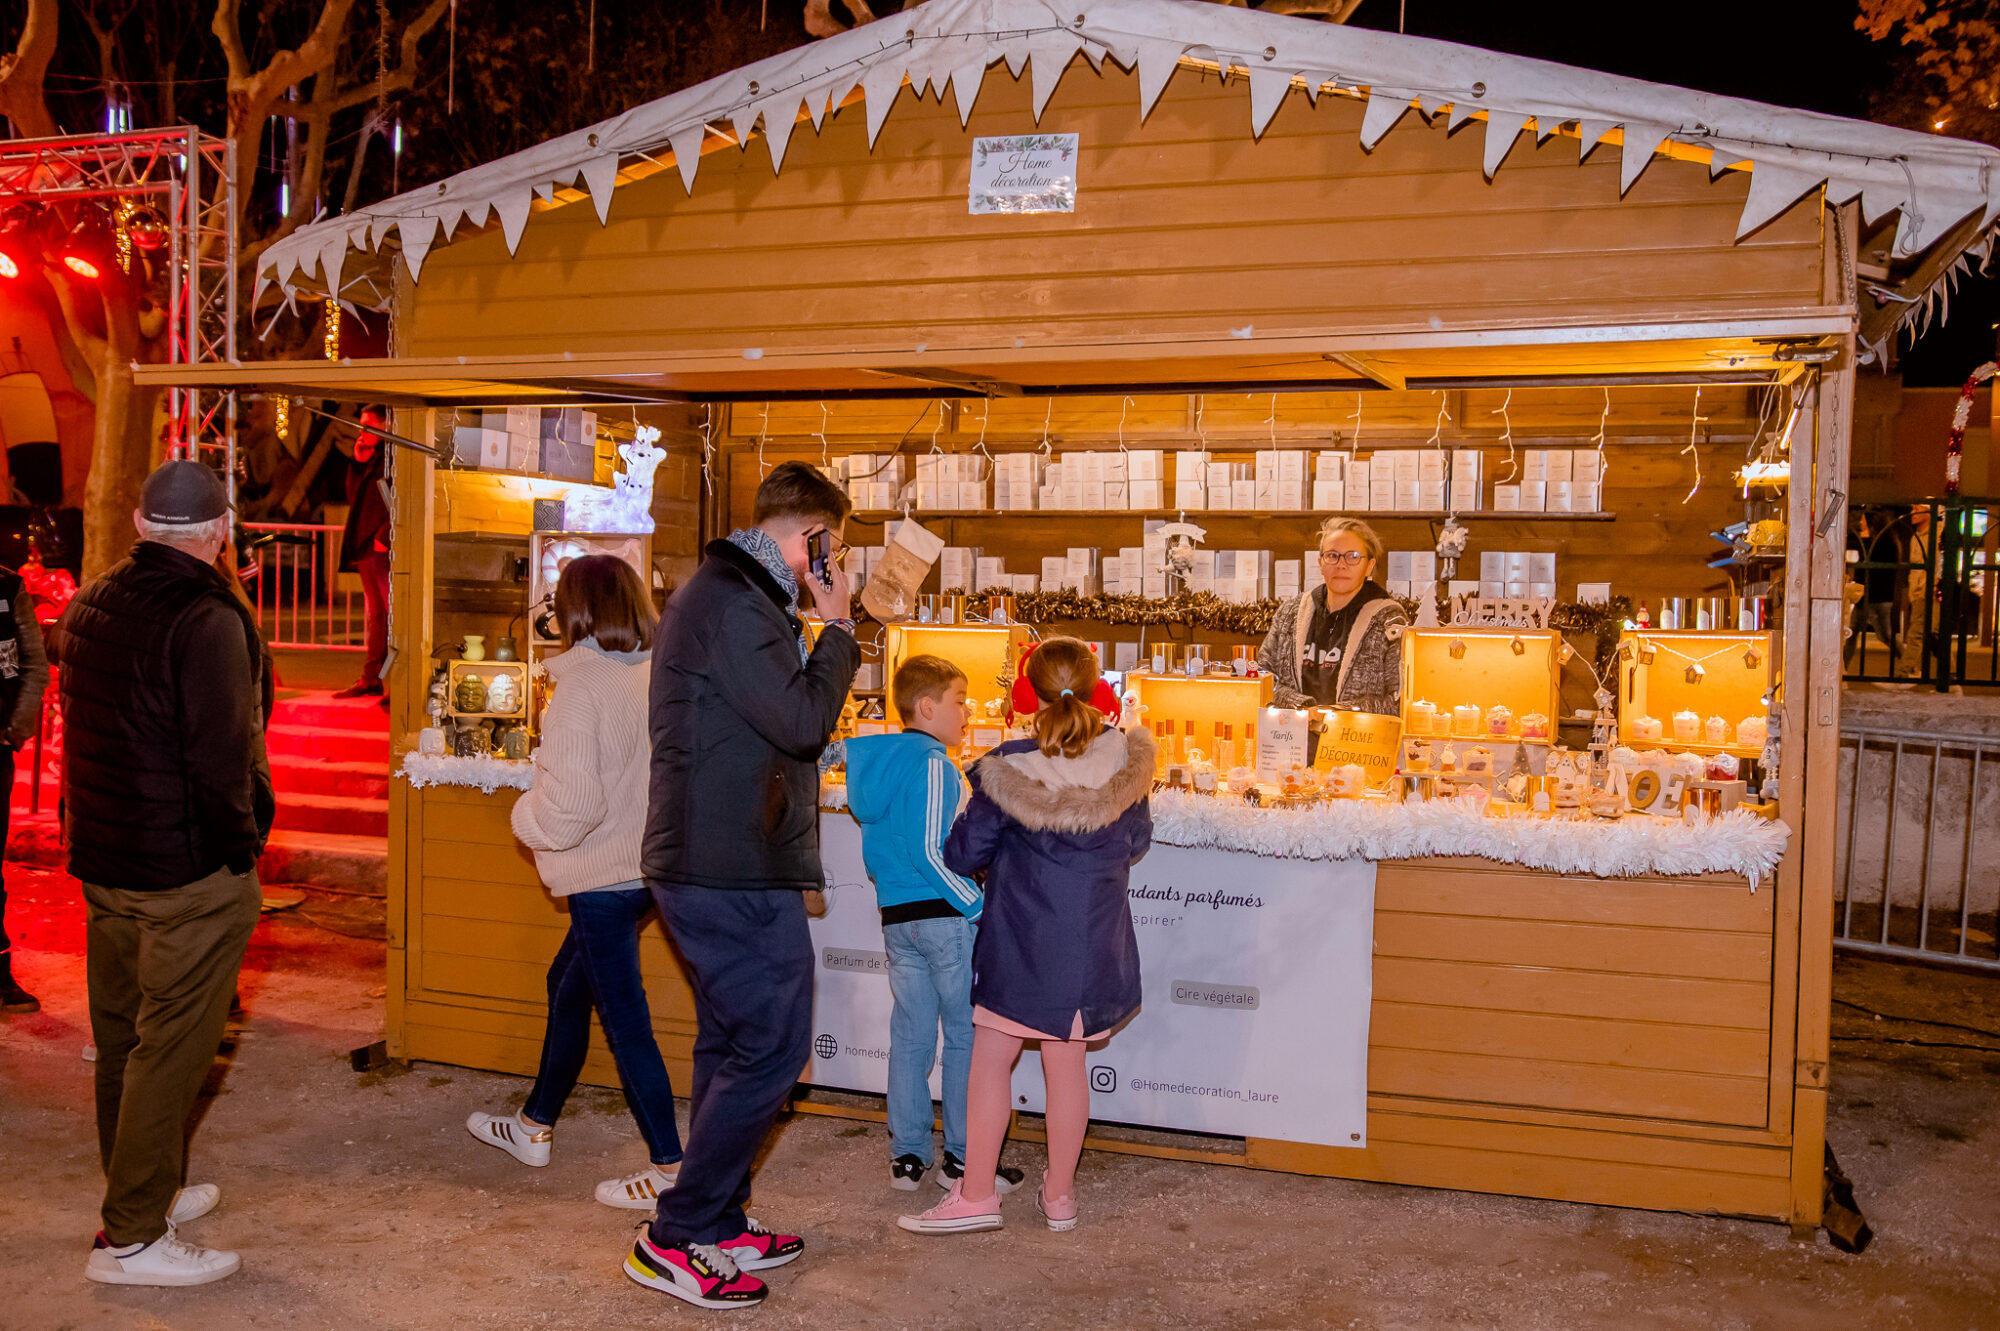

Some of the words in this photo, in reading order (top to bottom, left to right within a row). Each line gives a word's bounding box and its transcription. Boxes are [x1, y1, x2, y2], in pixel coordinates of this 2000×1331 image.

[999, 151, 1052, 174] Home
[990, 173, 1052, 188] décoration
[1451, 597, 1557, 630] MERRY
[1454, 610, 1529, 627] Christmas
[1270, 730, 1294, 742] Tarifs
[1127, 884, 1183, 901] ndants
[1184, 889, 1265, 910] parfumés
[1132, 914, 1183, 927] spirer"
[827, 954, 865, 969] Parfum
[867, 956, 881, 969] de
[1176, 987, 1200, 1001] Cire
[1203, 989, 1254, 1005] végétale
[1130, 1078, 1279, 1103] @Homedecoration_laure
